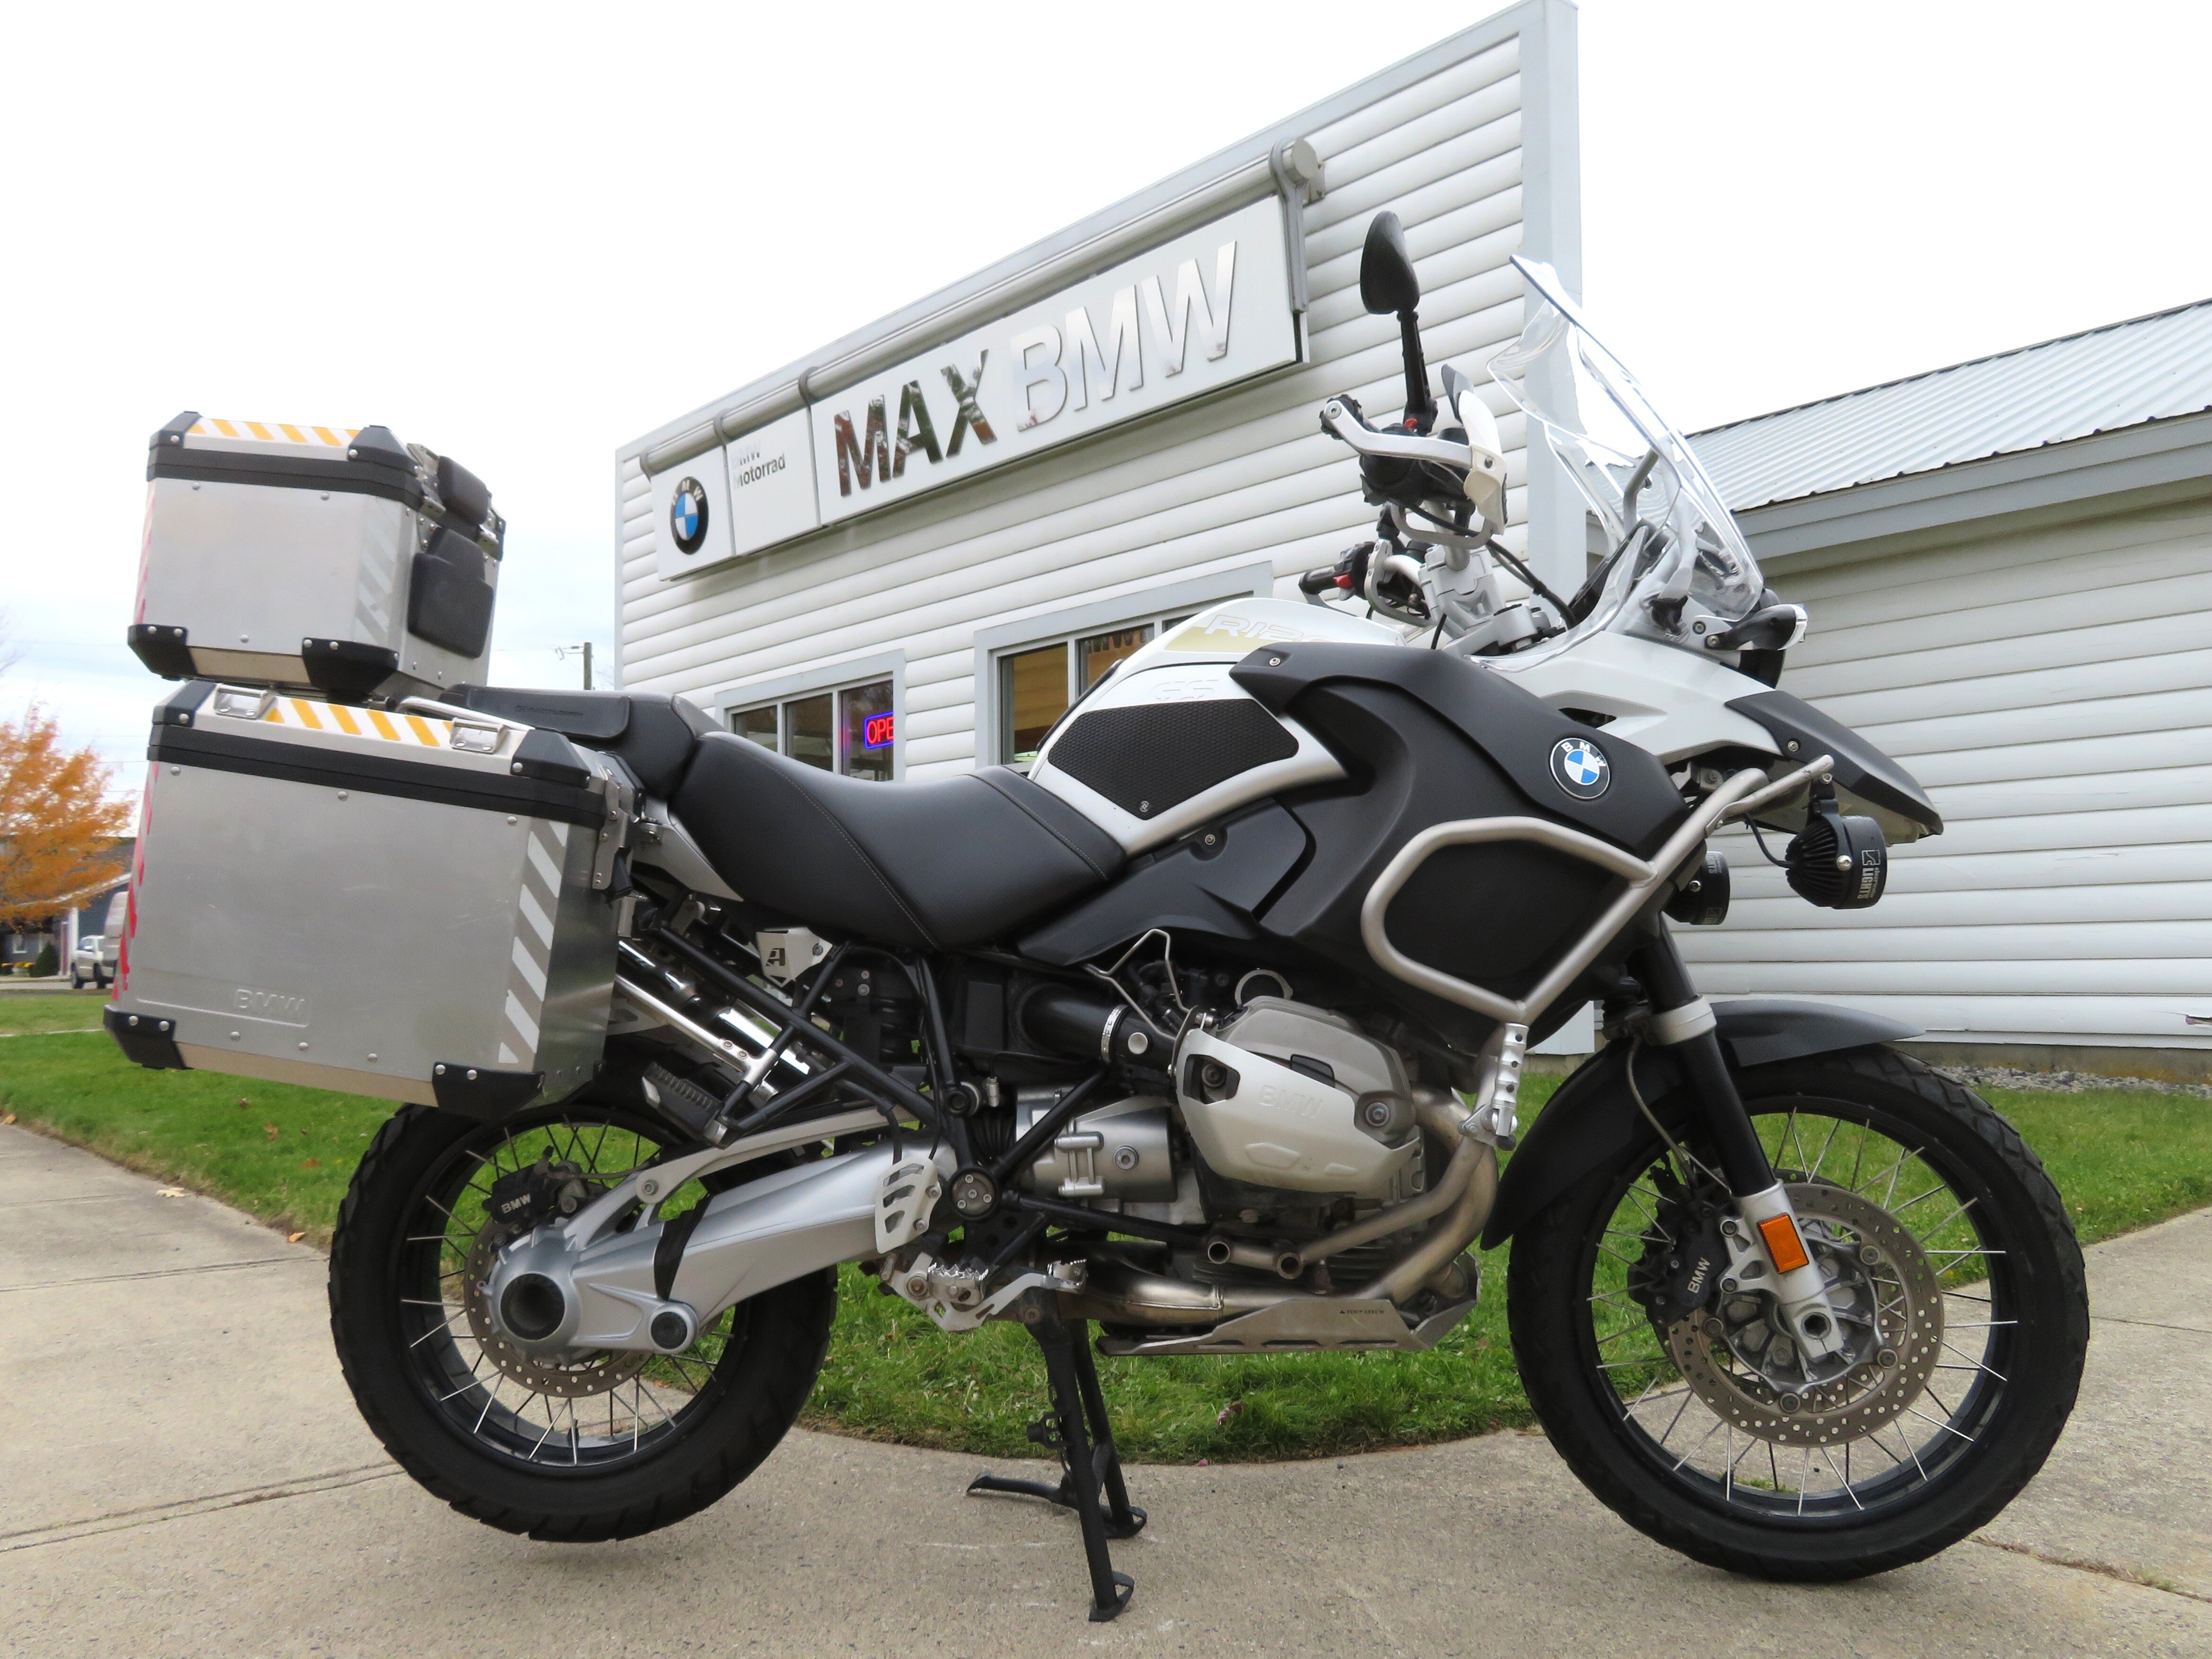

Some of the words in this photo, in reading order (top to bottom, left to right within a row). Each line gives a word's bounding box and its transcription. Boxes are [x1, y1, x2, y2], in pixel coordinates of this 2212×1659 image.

[834, 349, 997, 498] MAX
[1011, 240, 1237, 432] BMW
[1561, 741, 1607, 767] BMW
[1857, 867, 1874, 899] LIGHTS
[235, 988, 305, 1017] BMW
[1260, 1084, 1324, 1118] BMW
[501, 1193, 531, 1214] BMW
[1687, 1257, 1710, 1293] BMW
